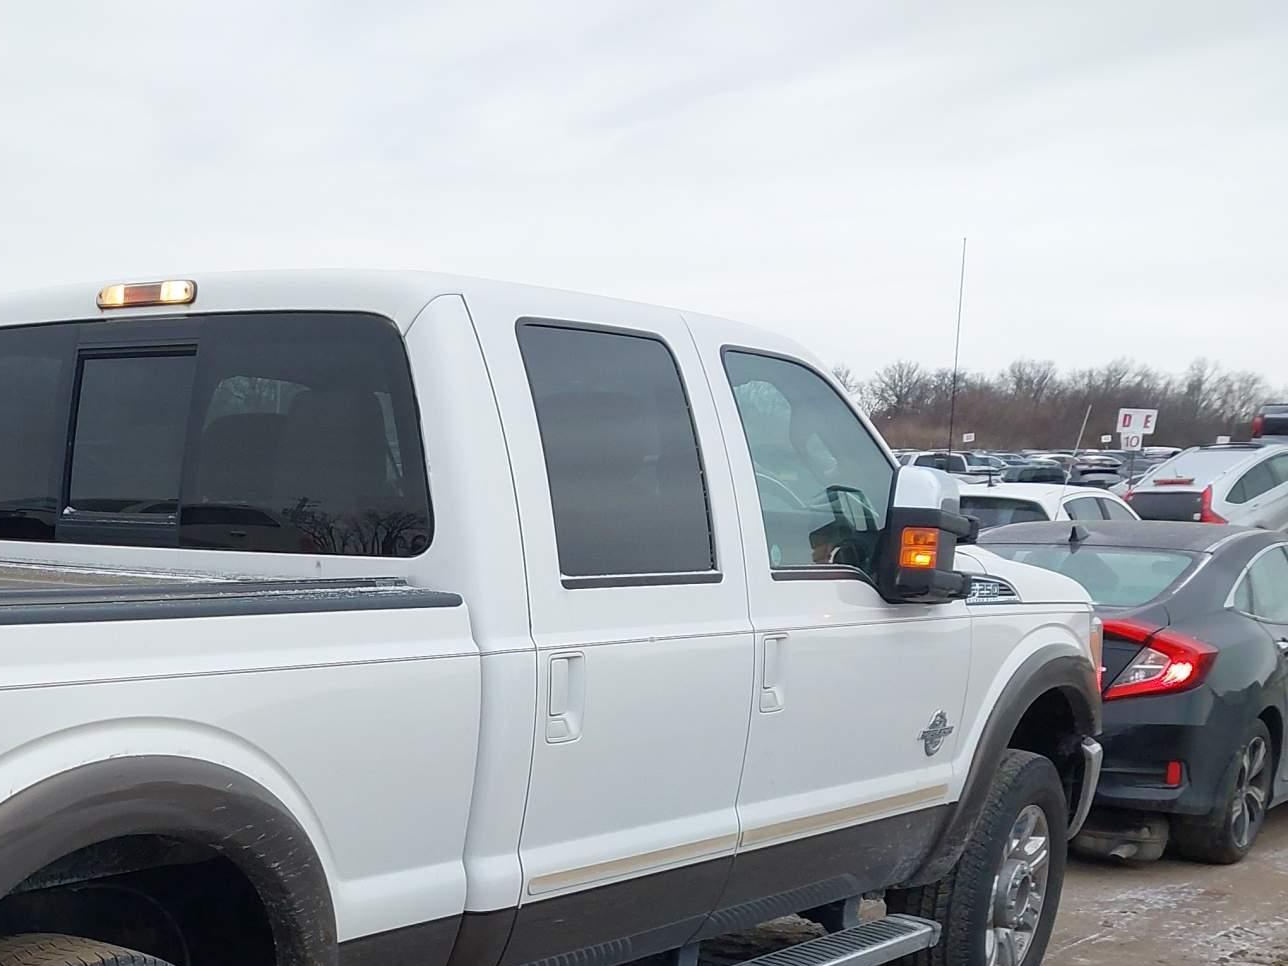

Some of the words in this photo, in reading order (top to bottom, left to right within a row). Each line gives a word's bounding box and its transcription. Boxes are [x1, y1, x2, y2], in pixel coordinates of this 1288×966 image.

[1122, 414, 1132, 427] D
[1144, 414, 1152, 428] E
[1124, 436, 1140, 447] 10
